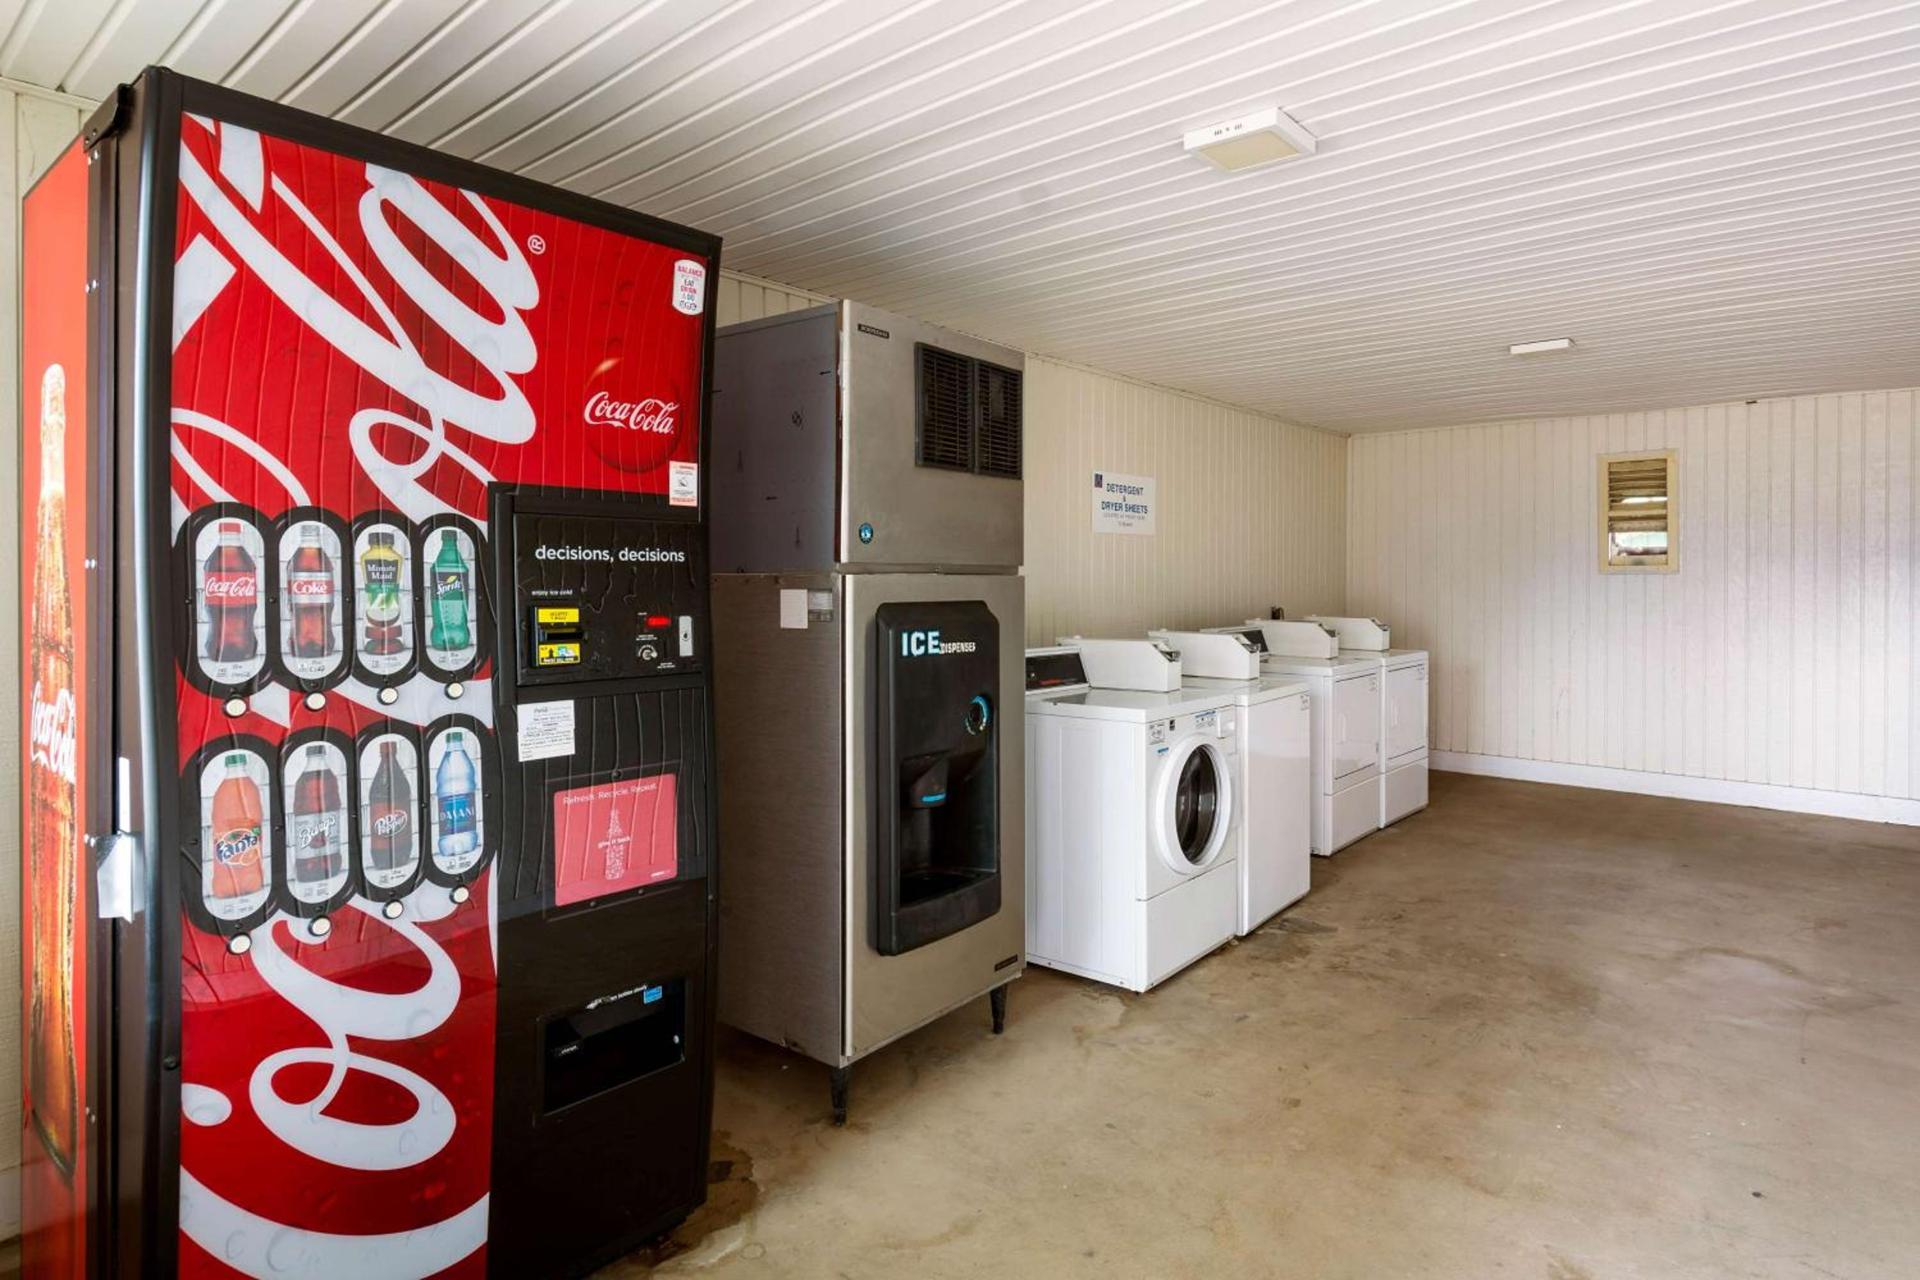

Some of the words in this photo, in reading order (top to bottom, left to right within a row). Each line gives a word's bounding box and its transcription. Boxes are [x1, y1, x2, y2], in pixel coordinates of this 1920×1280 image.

[583, 391, 679, 434] Coca-Cola
[1106, 482, 1144, 495] DETERGENT
[1101, 500, 1123, 512] DRYER
[1124, 503, 1149, 514] SHEETS
[535, 545, 614, 563] decisions,
[619, 547, 685, 562] decisions
[367, 563, 396, 572] Minute
[371, 571, 393, 580] Maid
[293, 581, 327, 594] Coke
[437, 580, 464, 595] Sprite
[902, 630, 940, 657] ICE
[940, 641, 976, 655] DISPENSER
[215, 834, 258, 862] Fanta
